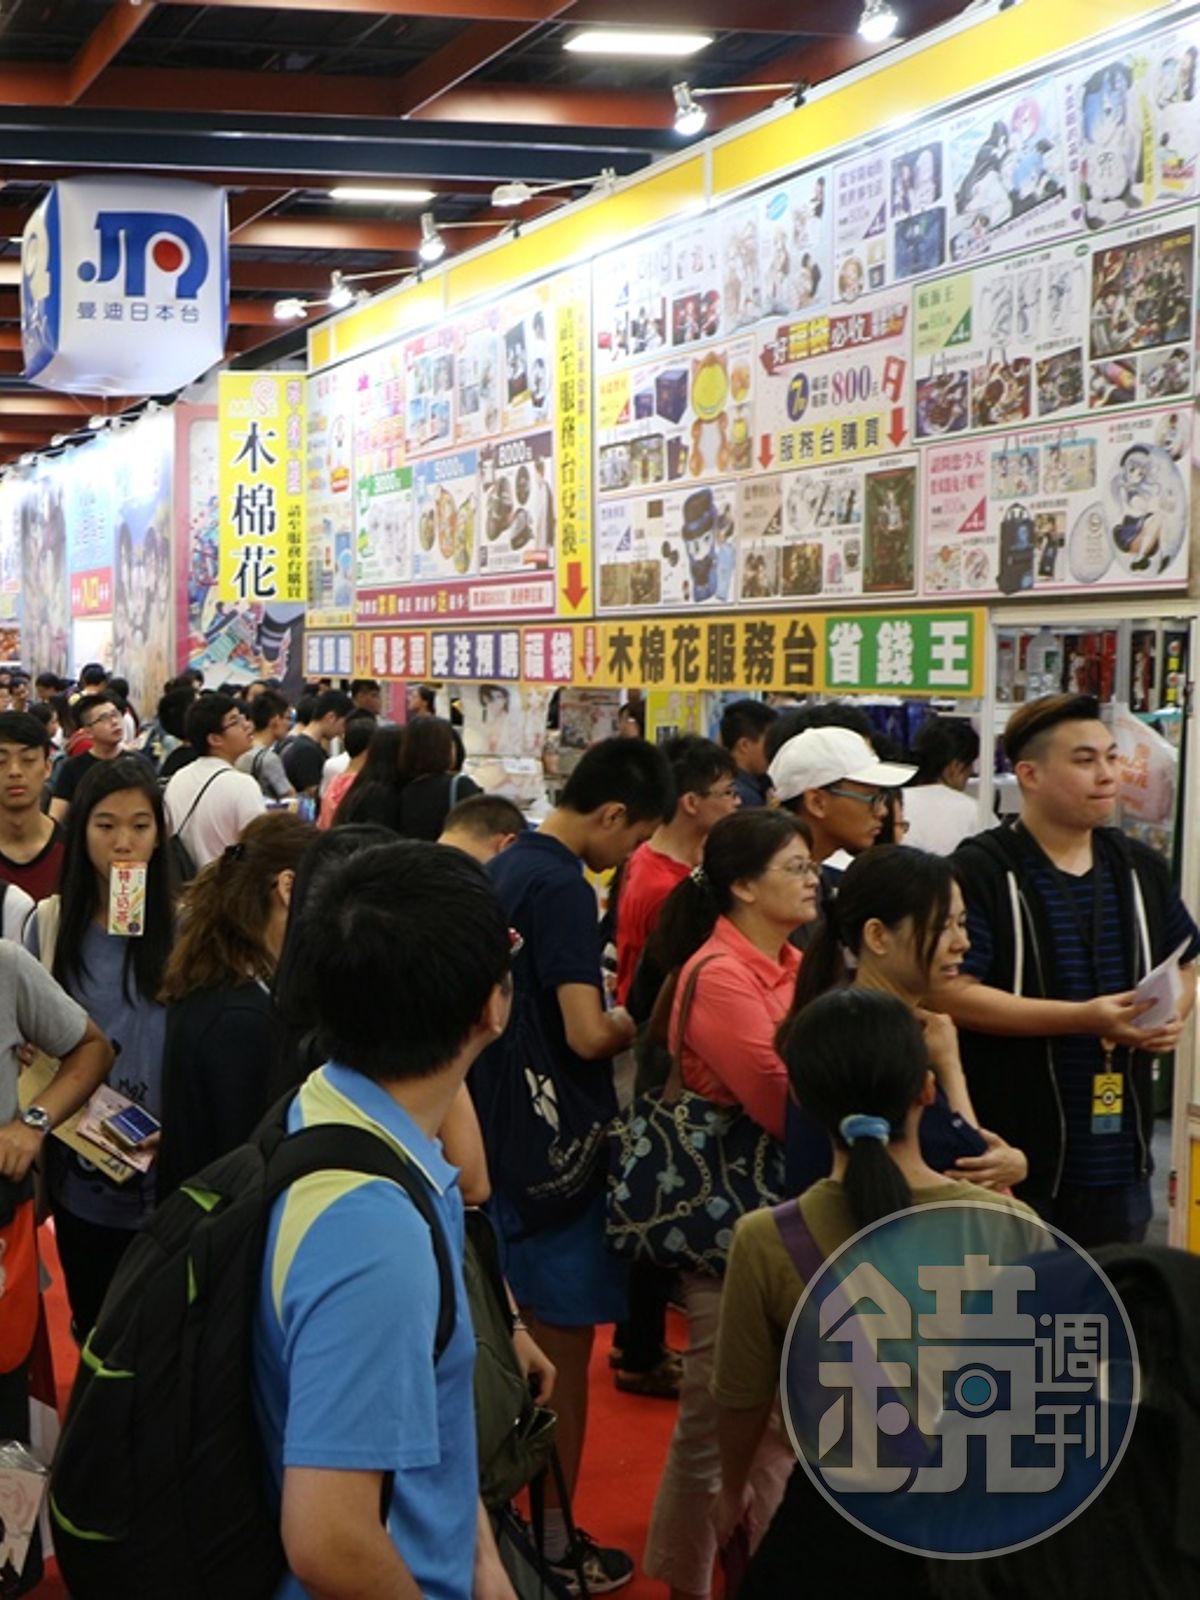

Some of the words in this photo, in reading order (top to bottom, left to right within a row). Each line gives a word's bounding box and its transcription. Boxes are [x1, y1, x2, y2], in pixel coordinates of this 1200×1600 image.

[231, 421, 277, 599] 木棉花
[608, 621, 817, 686] 木棉花服務台
[829, 620, 971, 685] 省錢王
